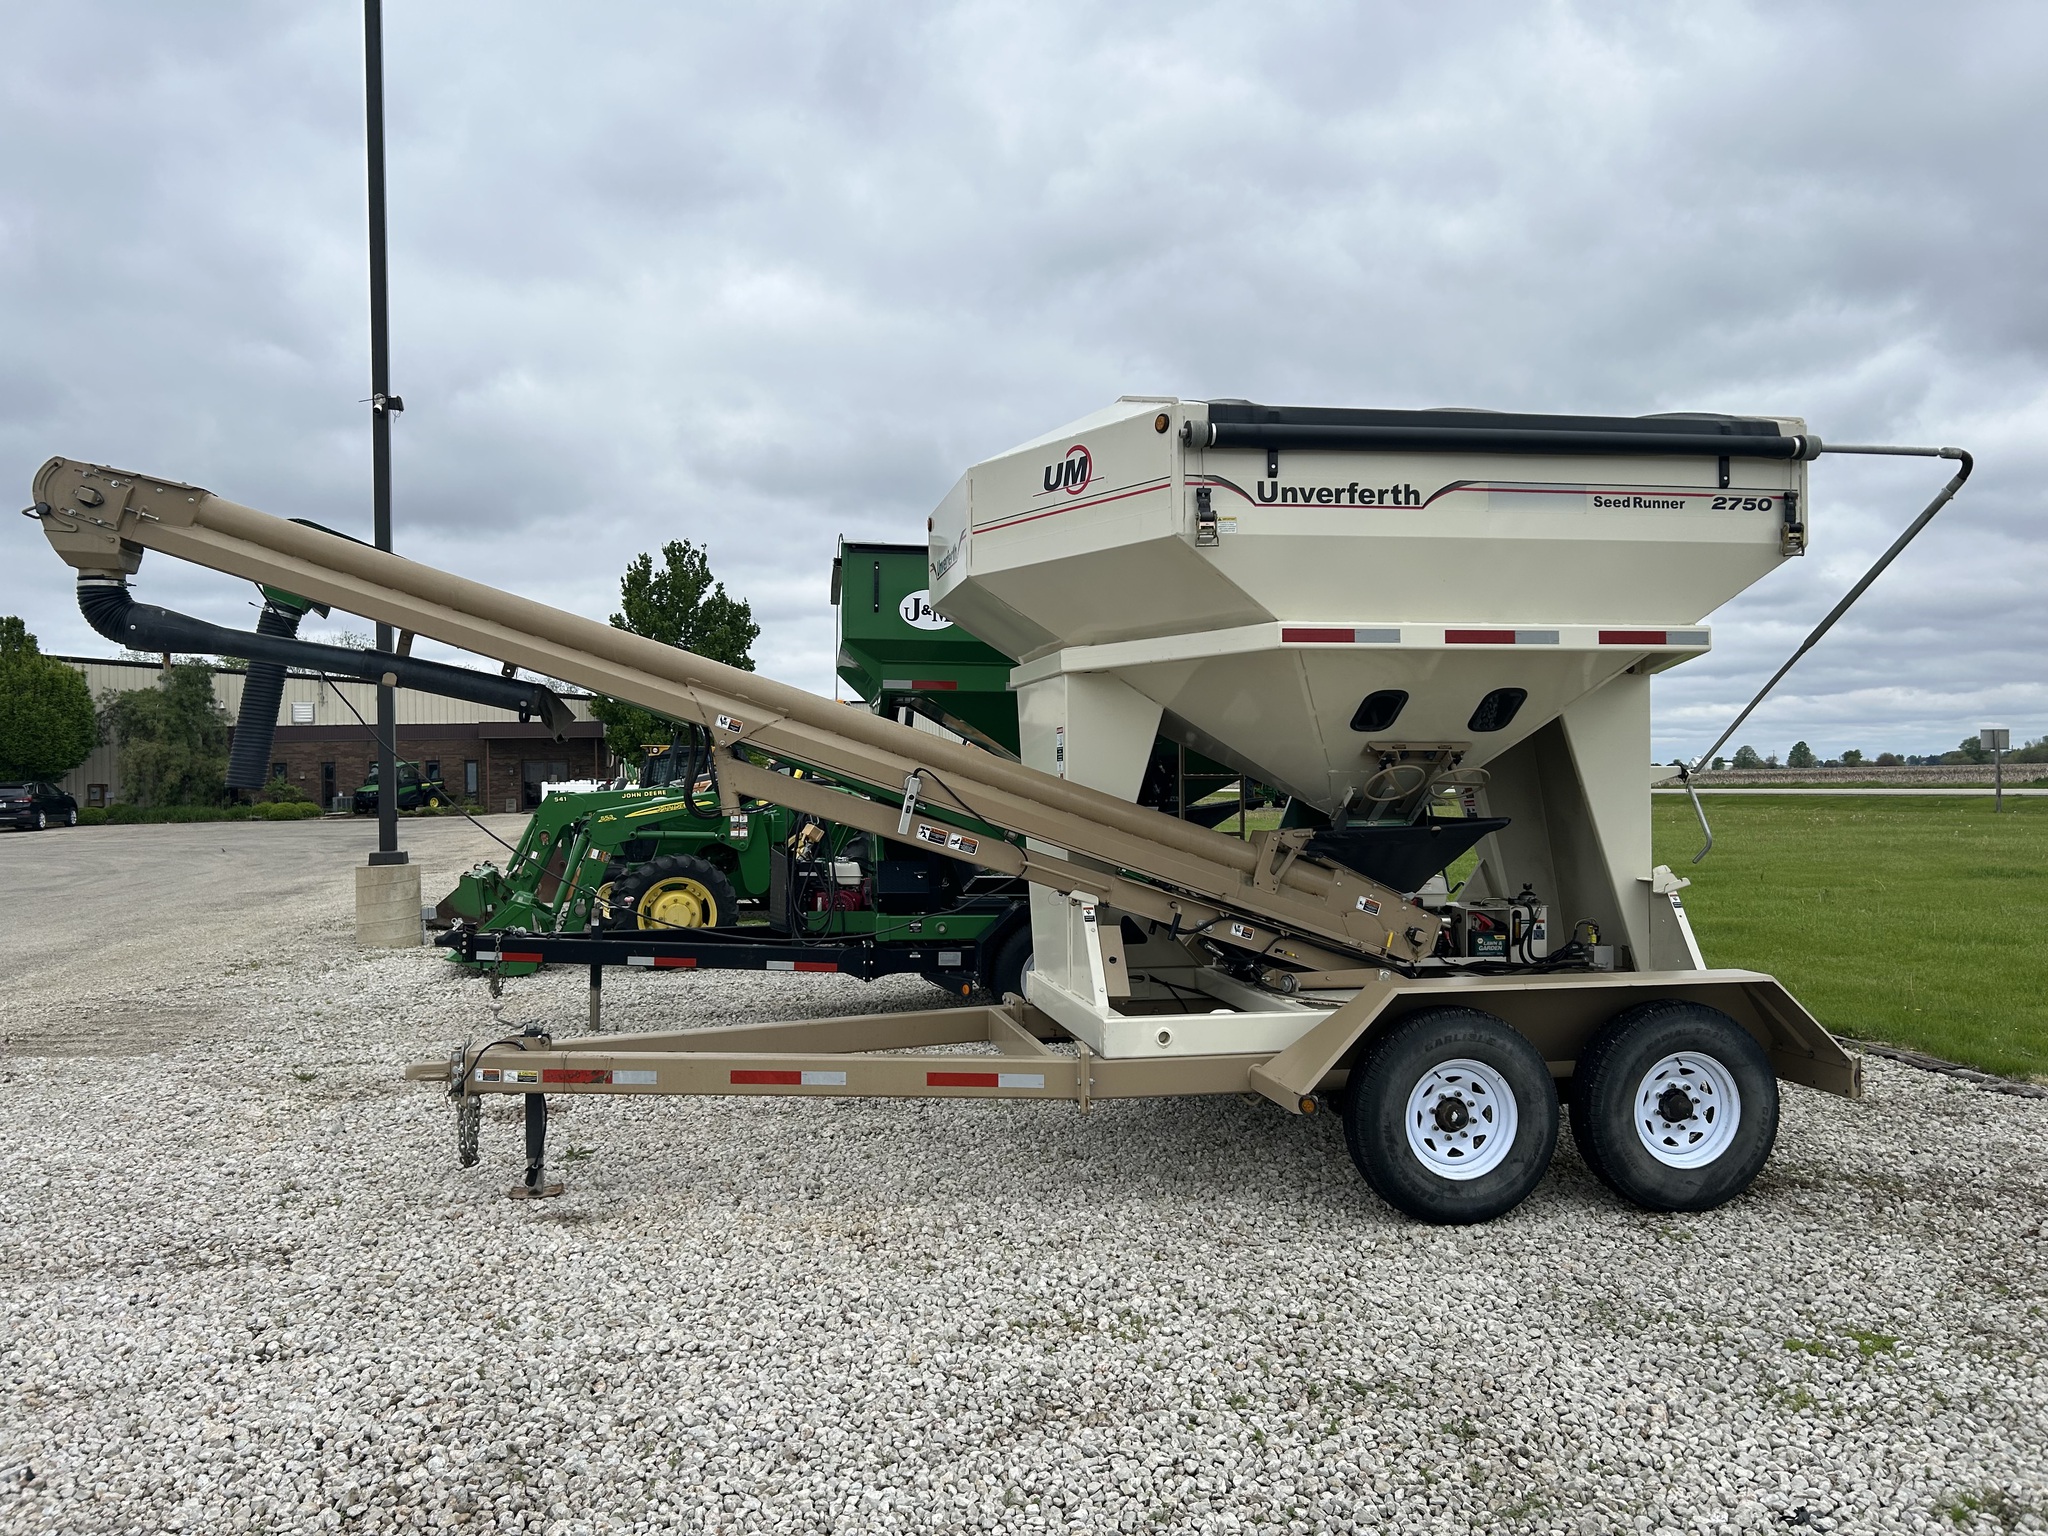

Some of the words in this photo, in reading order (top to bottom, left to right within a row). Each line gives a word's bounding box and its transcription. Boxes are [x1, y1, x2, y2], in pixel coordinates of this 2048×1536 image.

[1044, 456, 1088, 491] UM
[1257, 480, 1421, 506] Unverferth
[1593, 495, 1631, 508] Seed
[1633, 496, 1686, 509] Runner
[1711, 496, 1773, 512] 2750
